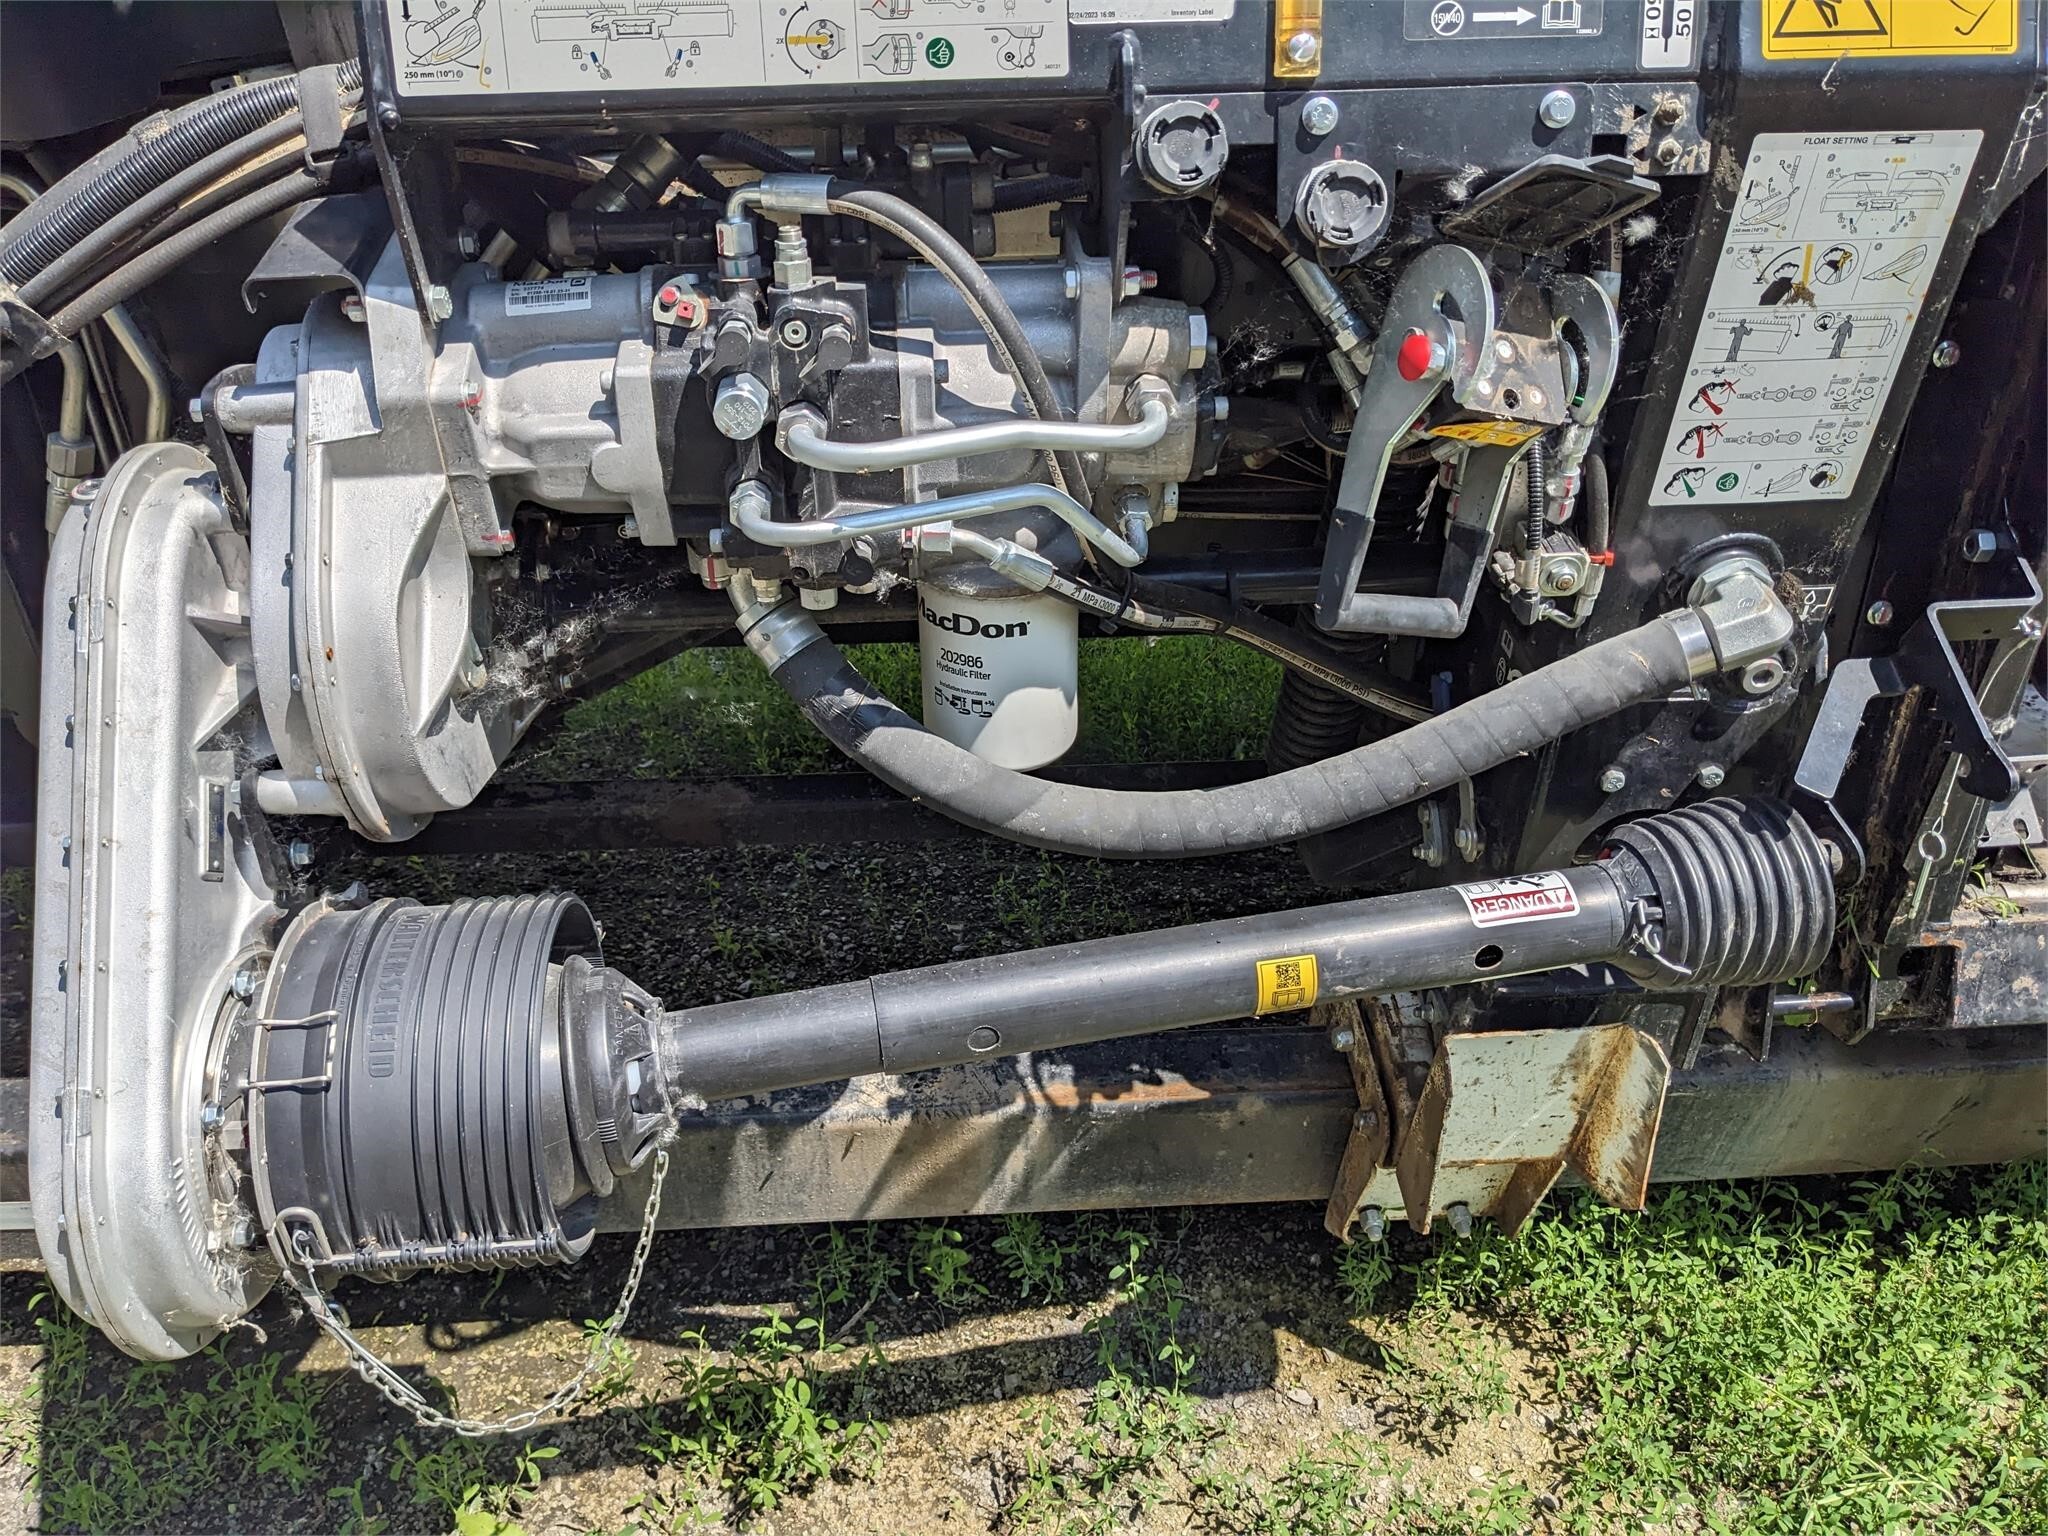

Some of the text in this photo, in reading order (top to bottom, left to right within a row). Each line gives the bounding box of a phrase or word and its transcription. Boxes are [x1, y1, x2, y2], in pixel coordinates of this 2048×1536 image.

[1198, 8, 1213, 16] Label
[404, 71, 419, 79] 250
[1803, 136, 1869, 145] FLOAT SETTING
[1070, 585, 1082, 598] 21
[1082, 588, 1099, 606] MPa
[940, 648, 983, 669] 202986
[936, 660, 991, 681] Hydraulic Filter
[1302, 661, 1312, 670] 21
[1312, 665, 1329, 679] MPa
[1352, 683, 1370, 698] PSI)
[960, 686, 987, 697] Instructions
[1473, 891, 1545, 914] DANGER
[368, 912, 431, 1078] WALTERSCHEID
